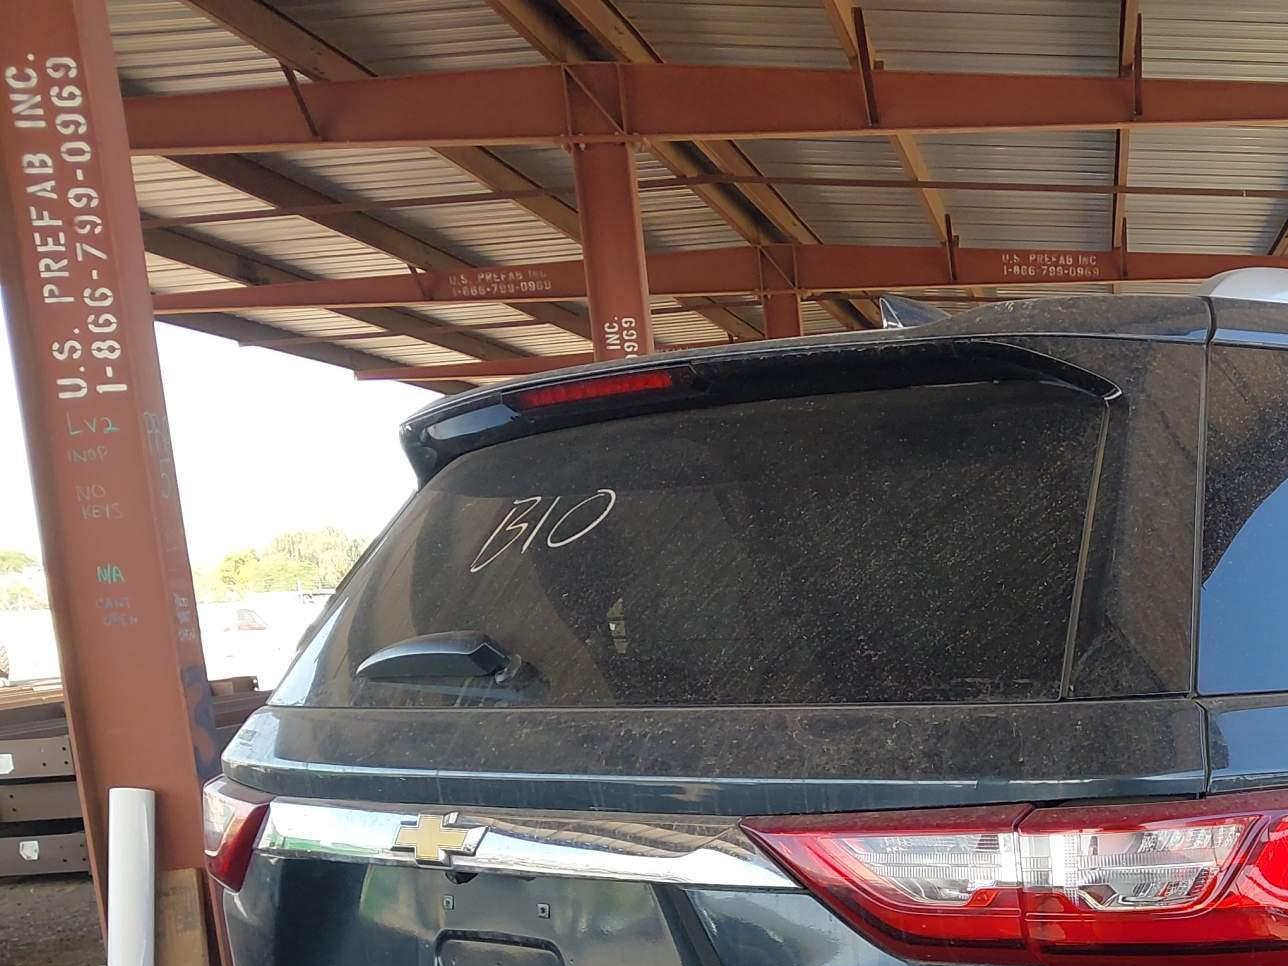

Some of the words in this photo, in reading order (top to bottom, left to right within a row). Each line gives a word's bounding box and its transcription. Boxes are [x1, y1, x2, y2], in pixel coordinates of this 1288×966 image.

[4, 53, 46, 128] INC.
[21, 153, 75, 303] PREFAB
[45, 57, 128, 394] 1-866-799-0969
[1029, 254, 1073, 265] PREFAB
[478, 271, 524, 283] PREFAB
[52, 327, 88, 399] U.S.
[603, 316, 622, 350] INC.
